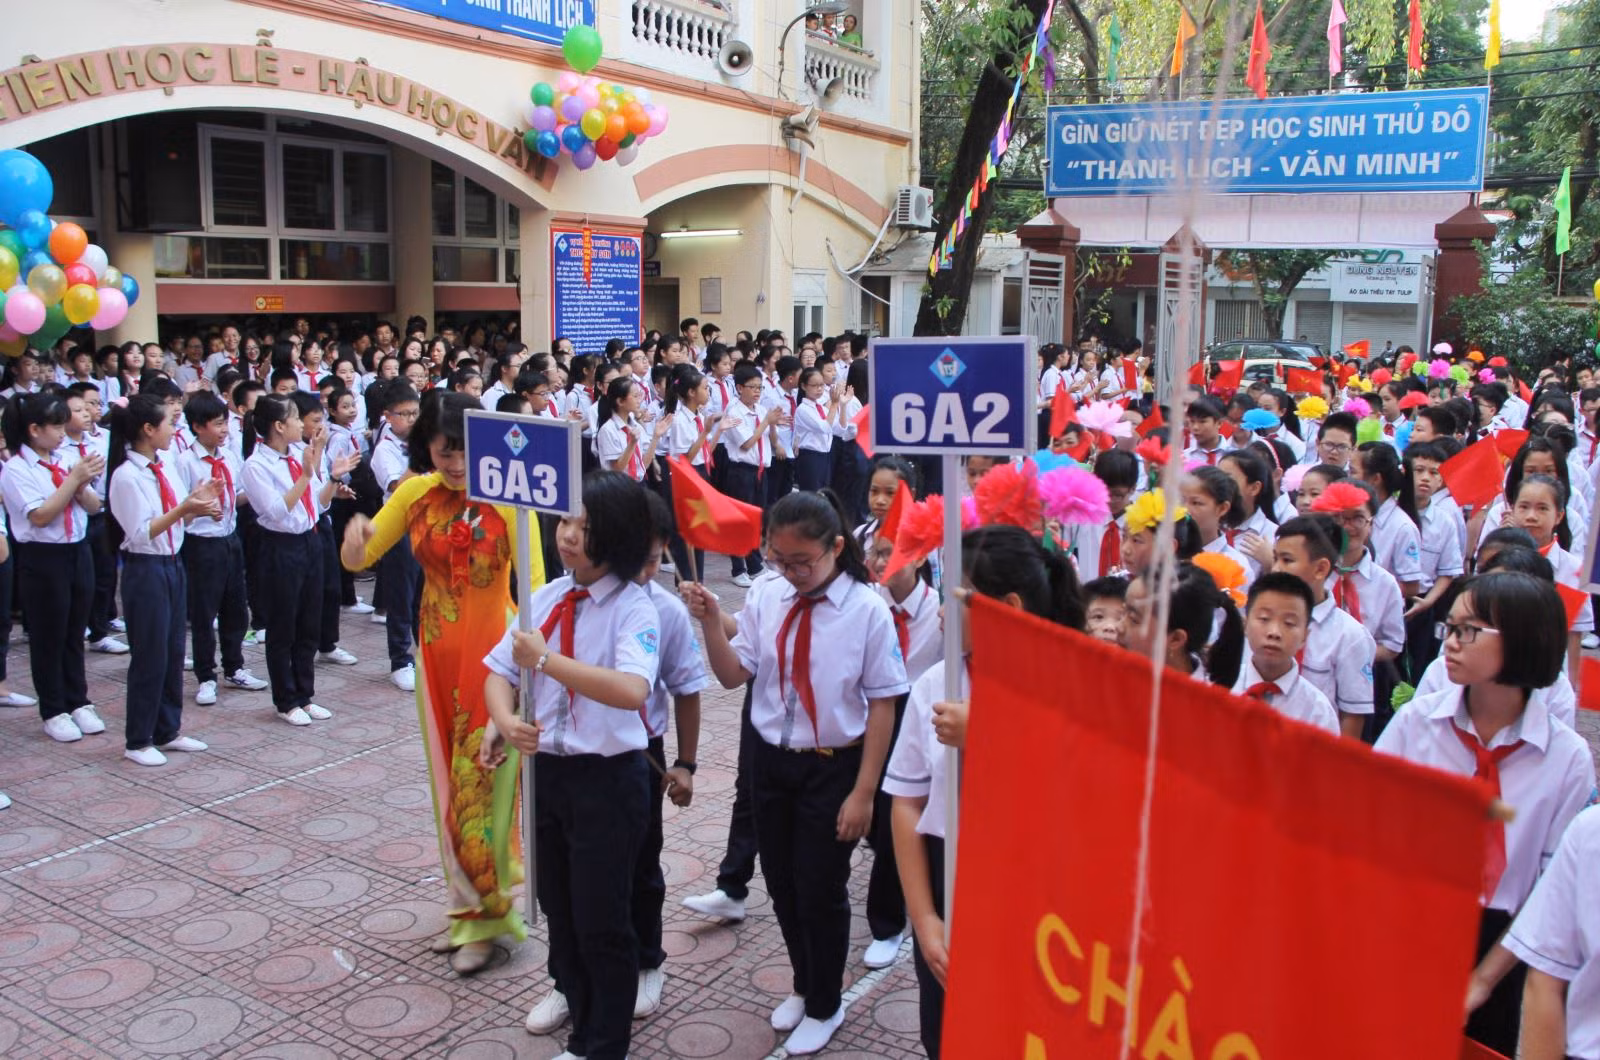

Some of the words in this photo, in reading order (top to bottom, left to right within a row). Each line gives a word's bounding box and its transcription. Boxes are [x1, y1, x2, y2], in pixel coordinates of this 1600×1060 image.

[0, 54, 102, 121] IÊN
[106, 47, 217, 97] HỌC
[228, 28, 281, 86] LỄ
[319, 57, 402, 109] HẬU
[407, 84, 479, 136] HỌC
[1061, 119, 1099, 145] GÌN
[1105, 117, 1145, 143] GIỮ
[1150, 116, 1193, 142] NÉT
[1251, 116, 1301, 146] HỌC
[1308, 114, 1365, 137] SINH
[1373, 102, 1424, 135] THỦ
[1431, 104, 1470, 133] ĐÔ
[1187, 157, 1252, 184] LỊCH
[1279, 149, 1346, 177] VĂN
[891, 392, 1010, 444] 6A2
[479, 455, 558, 506] 6A3
